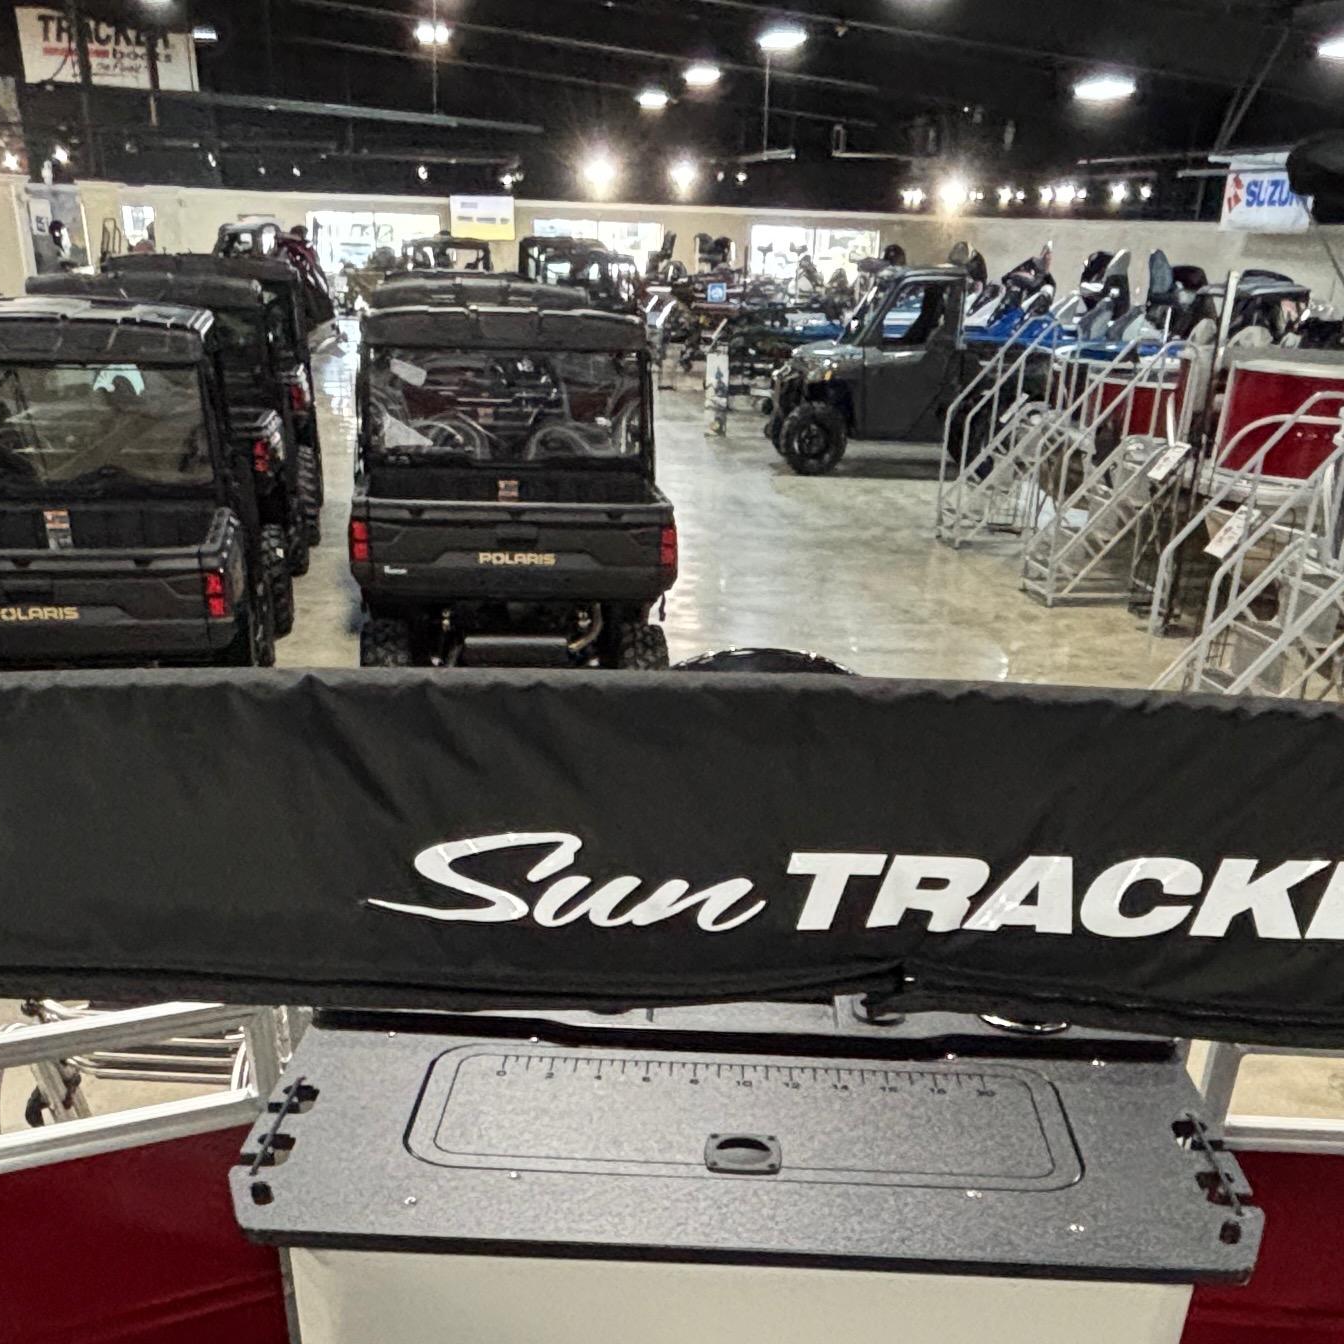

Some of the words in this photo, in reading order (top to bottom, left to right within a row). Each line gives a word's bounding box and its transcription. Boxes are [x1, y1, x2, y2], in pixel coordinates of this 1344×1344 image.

[1245, 179, 1308, 207] SUZU
[478, 552, 556, 565] POLARIS
[368, 831, 767, 932] Sun
